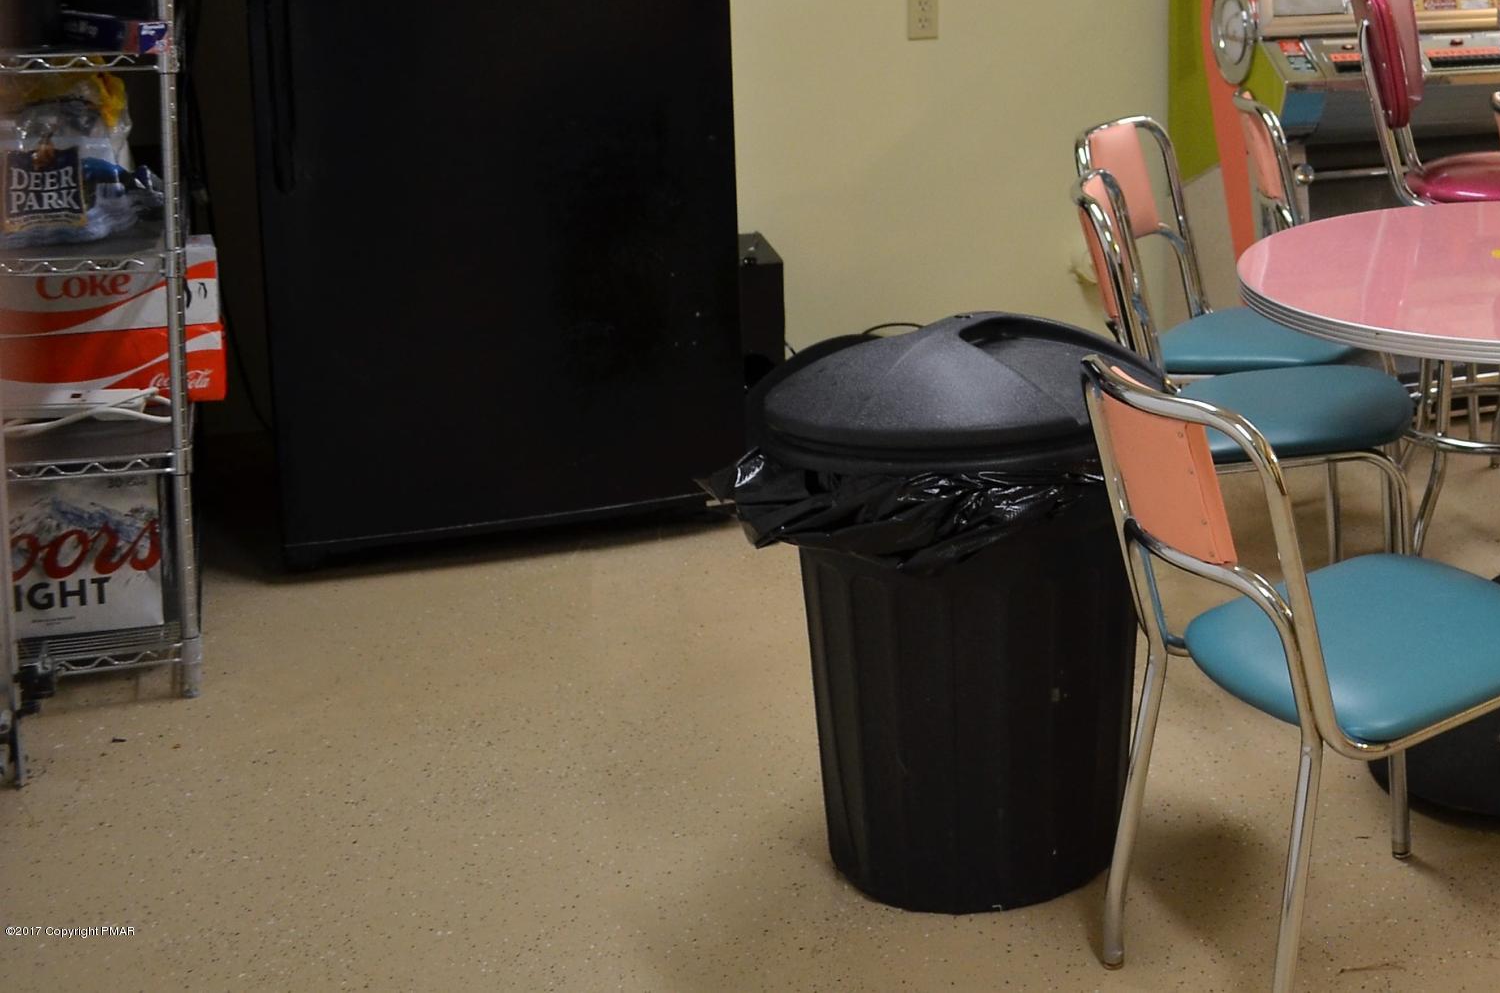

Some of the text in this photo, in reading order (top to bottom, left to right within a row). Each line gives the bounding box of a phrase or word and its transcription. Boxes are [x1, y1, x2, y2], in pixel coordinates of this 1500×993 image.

[10, 165, 77, 191] DEER
[9, 189, 81, 214] PARK
[35, 270, 132, 302] Coke
[10, 516, 162, 583] oors
[13, 576, 113, 613] IGHT
